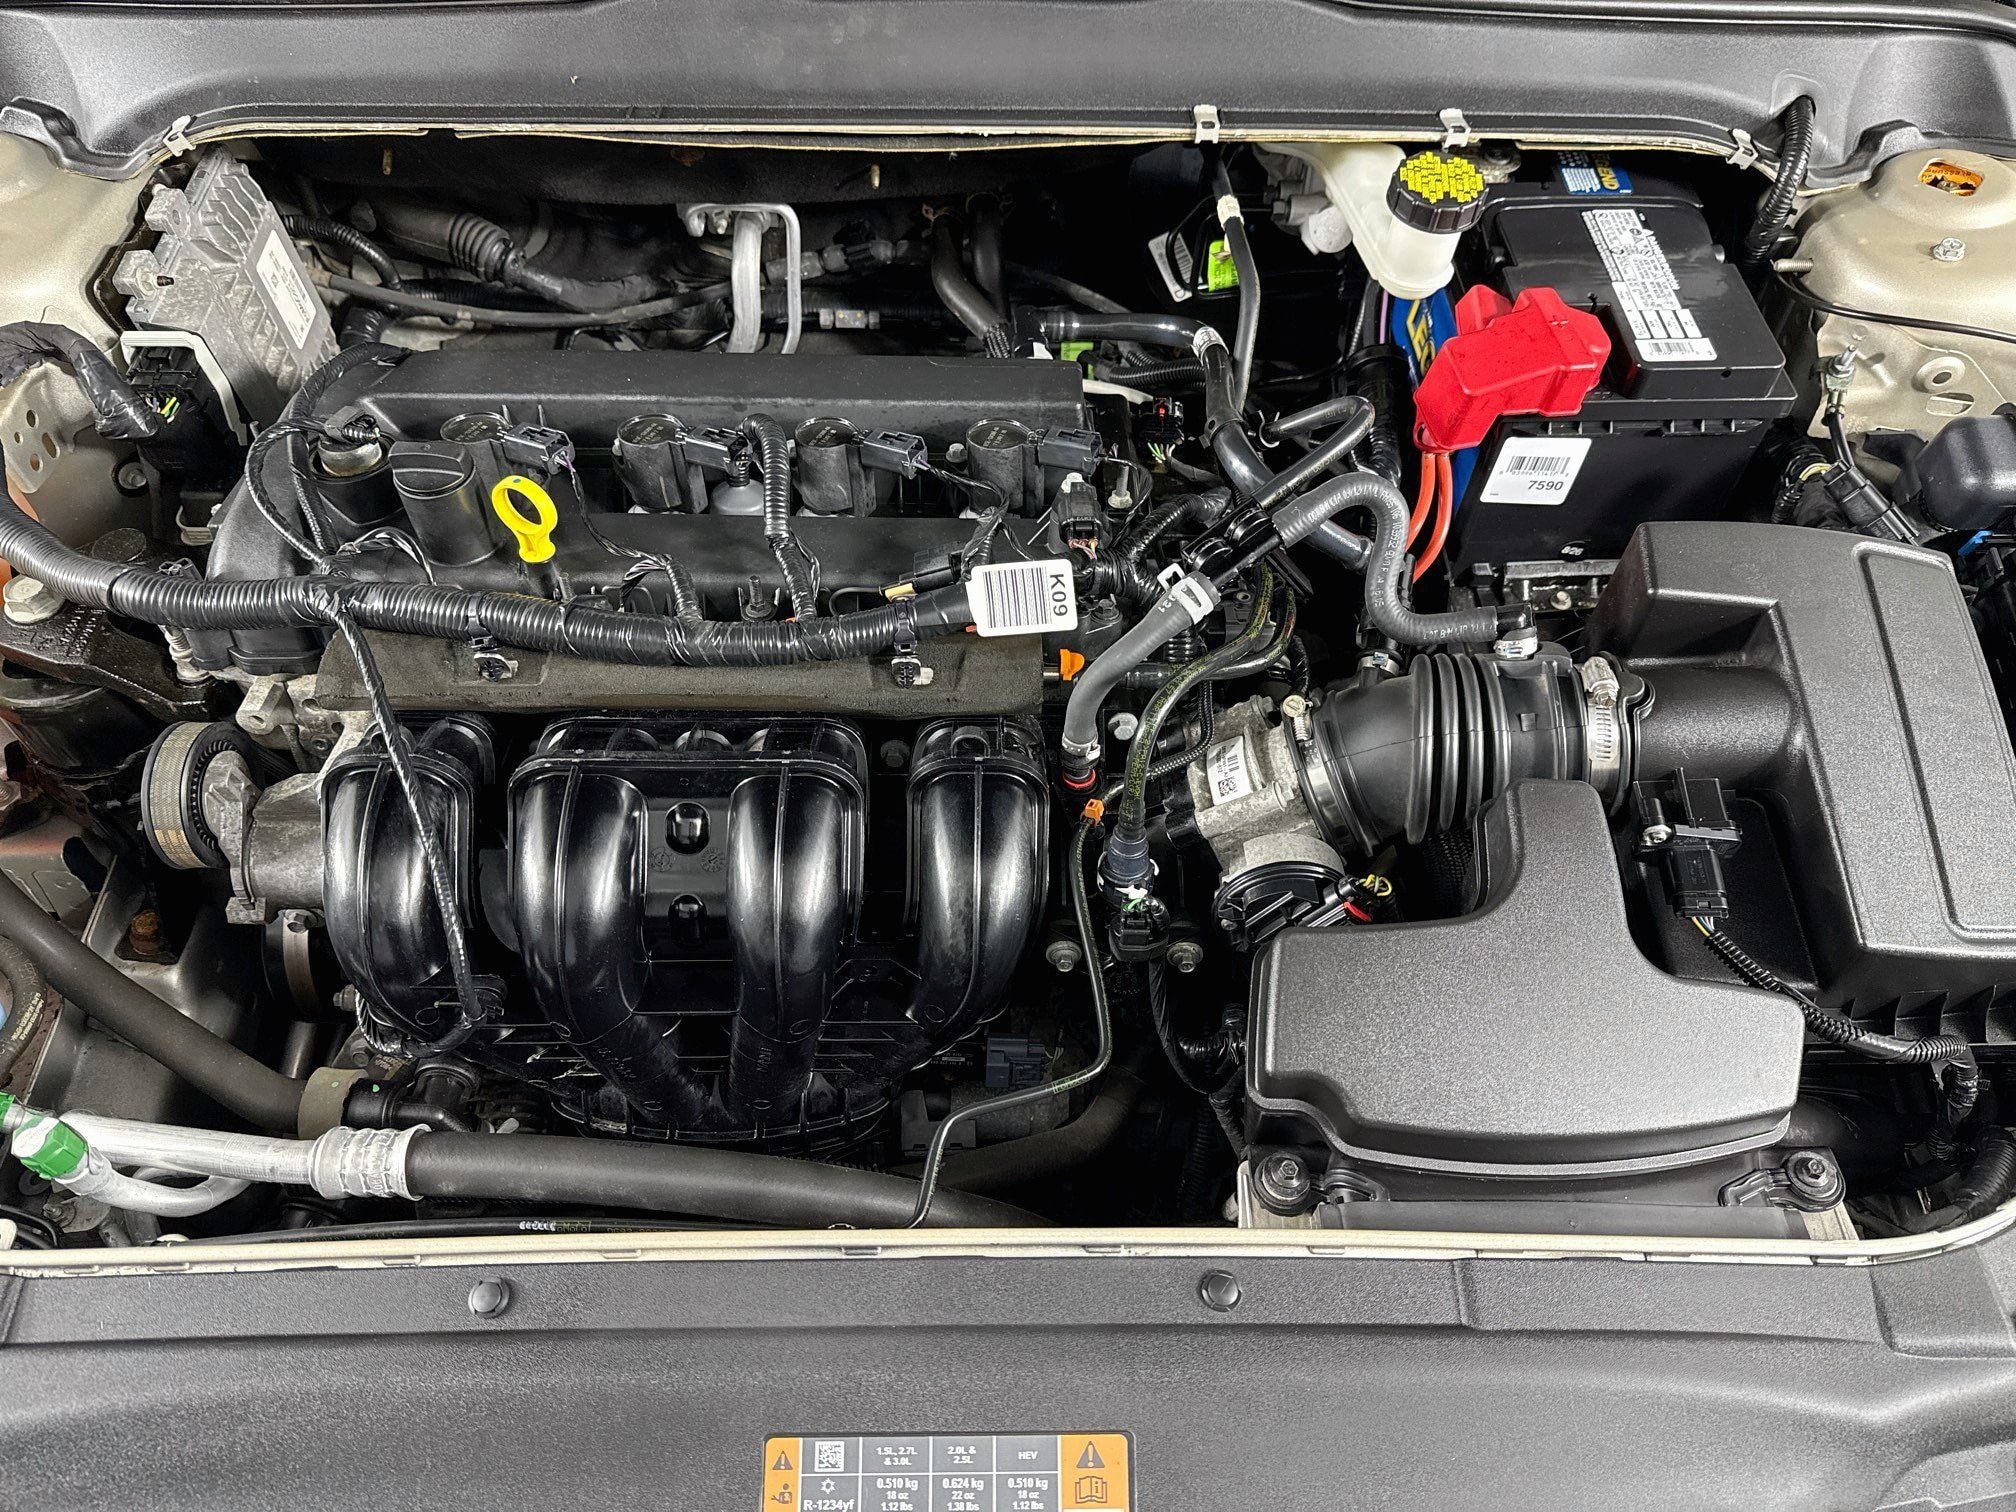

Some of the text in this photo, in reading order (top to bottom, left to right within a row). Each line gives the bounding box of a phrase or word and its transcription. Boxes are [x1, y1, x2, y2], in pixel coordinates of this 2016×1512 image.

[1527, 480, 1564, 491] 7590
[1049, 573, 1068, 617] K09
[899, 1446, 918, 1455] 2.7L
[948, 1446, 967, 1454] 2.0L
[953, 1456, 974, 1464] 2.5L
[1018, 1451, 1038, 1460] HEV
[876, 1478, 918, 1490] 0.510 kg
[942, 1478, 984, 1490] 0.624 kg
[1008, 1478, 1048, 1490] 0.510 kg
[886, 1491, 909, 1500] 18 oz
[952, 1491, 975, 1500] 22 oz
[1018, 1491, 1027, 1499] 18
[803, 1499, 855, 1512] R-1234yf
[881, 1502, 914, 1511] 1.12 lbs
[947, 1502, 980, 1512] 1.38 lbs
[1012, 1502, 1044, 1511] 1.12 lbs
